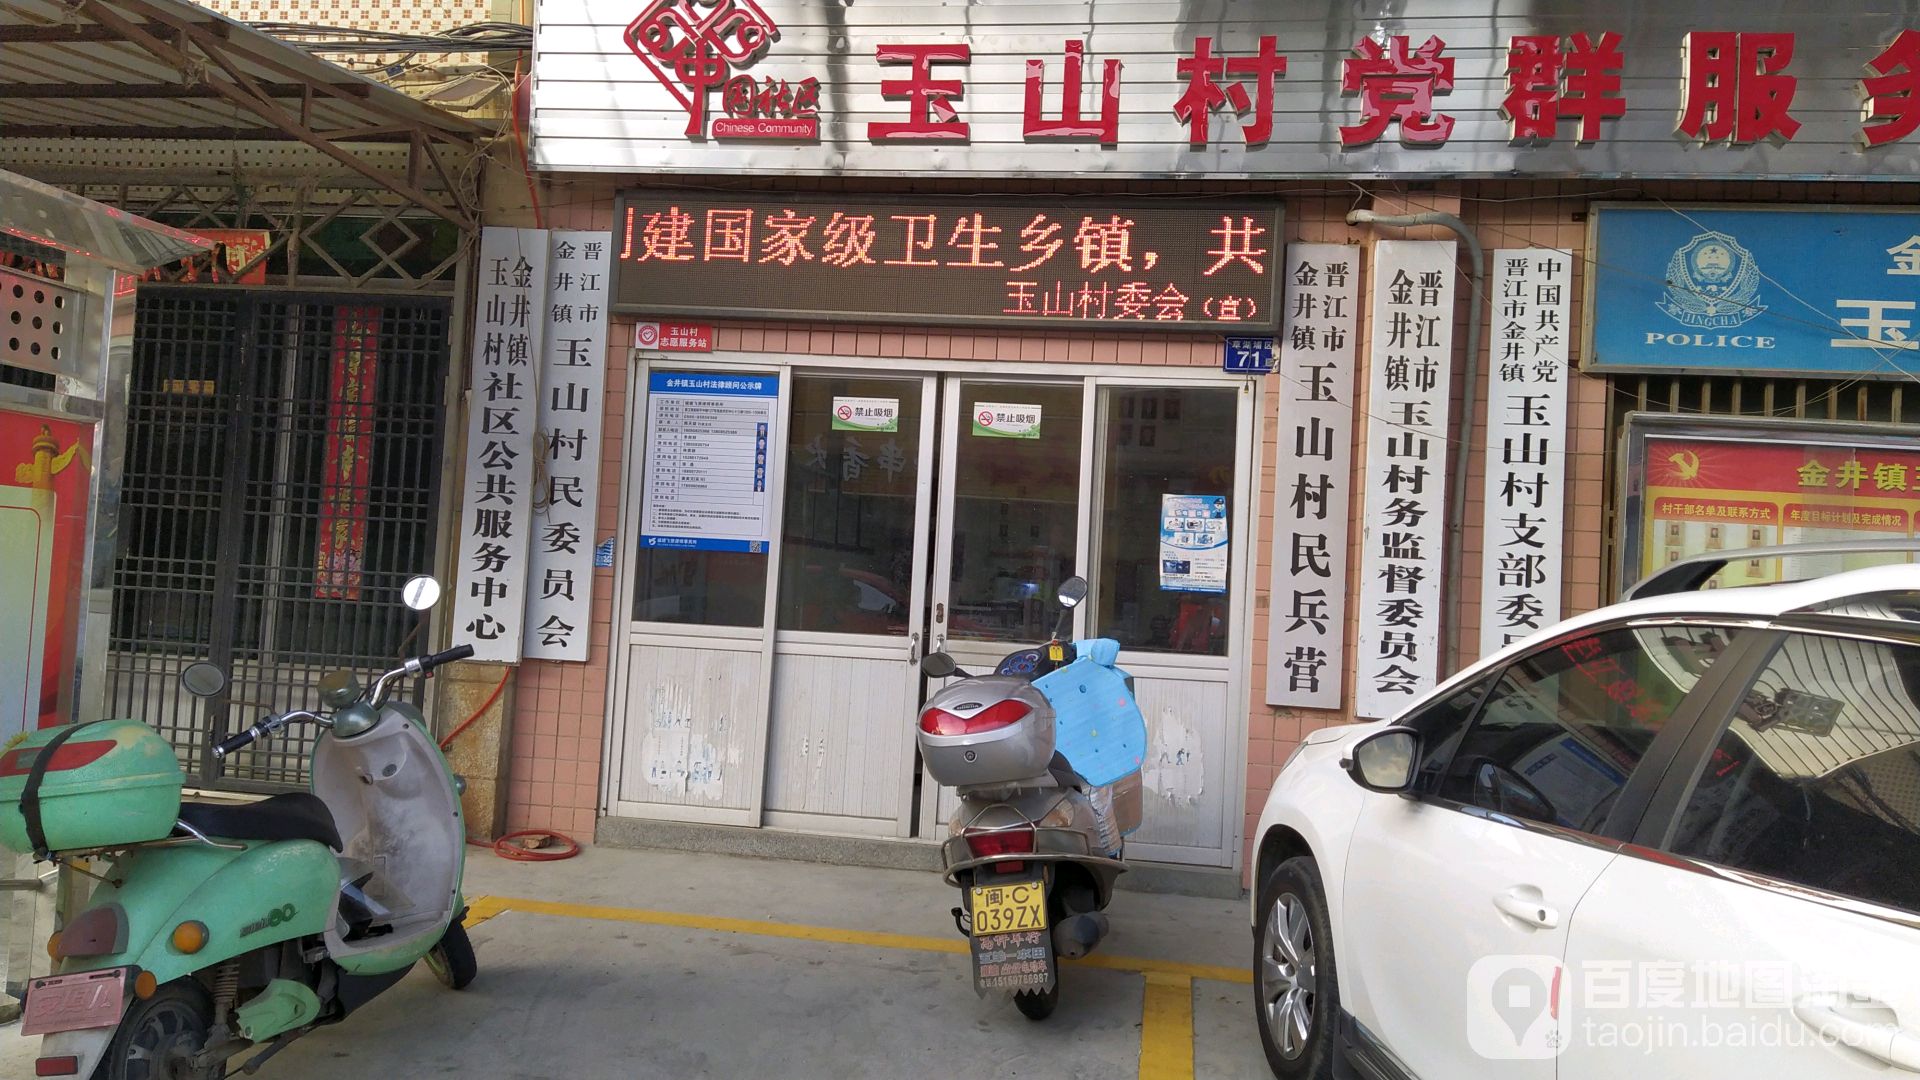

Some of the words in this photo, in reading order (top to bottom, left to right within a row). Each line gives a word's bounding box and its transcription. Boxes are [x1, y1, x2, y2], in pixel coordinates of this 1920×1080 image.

[715, 122, 755, 133] Chinese
[758, 122, 813, 135] Community
[482, 256, 510, 367] 玉山村
[506, 255, 534, 367] 金井镇
[551, 240, 577, 324] 金井镇
[578, 241, 603, 323] 晋江市
[1290, 260, 1319, 352] 金井镇
[1322, 261, 1350, 352] 晋江市
[1499, 257, 1529, 383] 晋江市金井镇
[1532, 257, 1562, 383] 中国共产党
[1684, 313, 1739, 327] JINGCHA
[660, 337, 707, 348] 志愿服务站
[670, 326, 698, 336] 玉山村
[1237, 350, 1260, 368] 71
[1384, 268, 1415, 392] 金井镇
[1413, 269, 1444, 393] 晋江市
[1644, 332, 1776, 349] POLICE
[855, 406, 893, 417] 禁止吸烟
[996, 412, 1036, 424] 禁止吸烟
[465, 371, 523, 640] 社区公共服务中心
[537, 337, 593, 648] 玉山村民委员会
[1662, 502, 1771, 519] 村干部名单及联系方式
[1796, 459, 1920, 492] 金井镇
[1284, 362, 1338, 693] 玉山村民兵营
[1373, 400, 1433, 695] 玉山村务监督委员会
[1790, 509, 1902, 527] 年度目标计划及完成情况
[976, 904, 1042, 931] 039ZX
